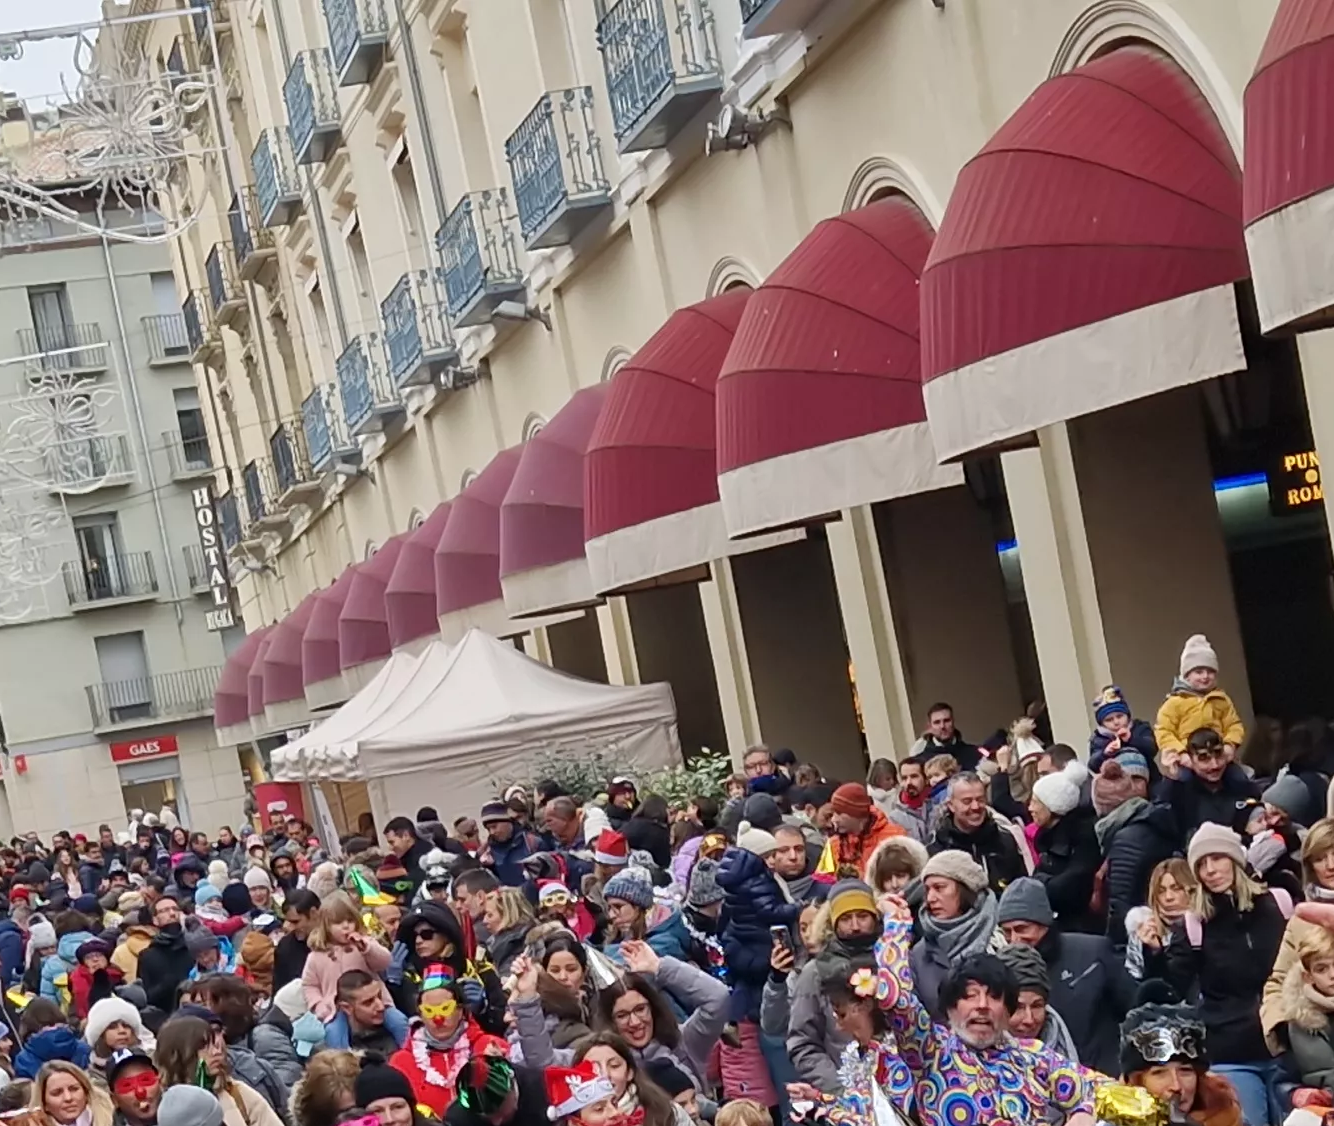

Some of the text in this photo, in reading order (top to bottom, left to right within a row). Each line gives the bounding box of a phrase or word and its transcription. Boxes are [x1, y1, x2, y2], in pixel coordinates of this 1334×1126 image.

[1284, 451, 1320, 472] PUN
[1287, 485, 1324, 505] ROM
[192, 487, 228, 605] HOSTAL
[129, 741, 160, 756] GAES
